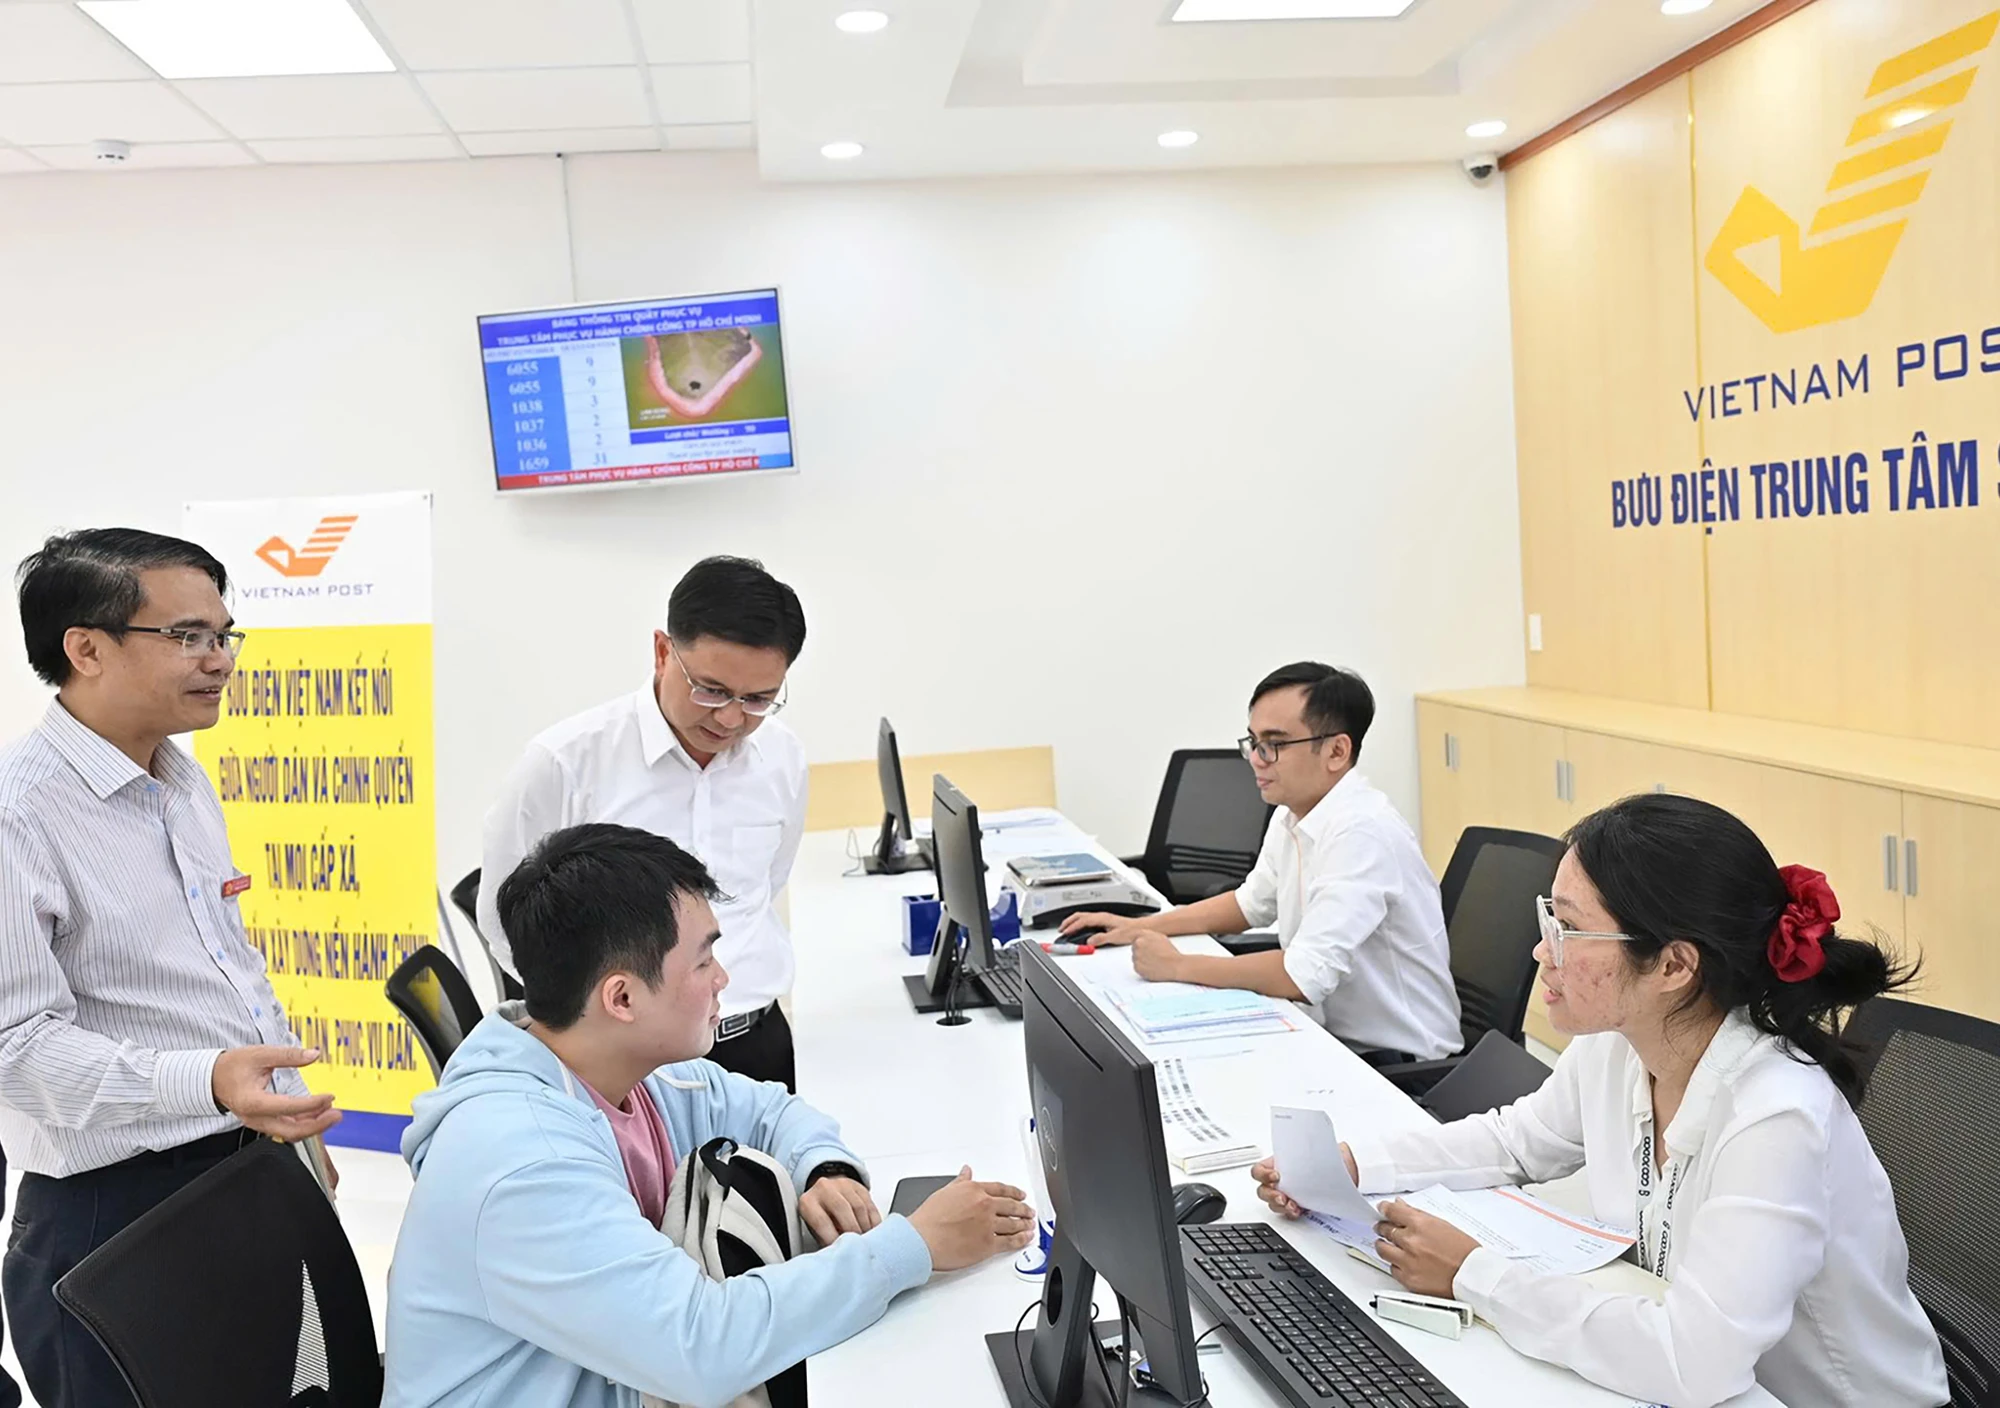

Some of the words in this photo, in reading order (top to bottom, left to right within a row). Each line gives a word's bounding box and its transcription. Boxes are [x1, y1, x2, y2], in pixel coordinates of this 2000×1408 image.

[685, 319, 697, 329] TP
[506, 361, 539, 376] 6055
[586, 357, 594, 367] 9
[508, 380, 541, 395] 6055
[588, 376, 596, 387] 9
[1683, 353, 1869, 422] VIETNAM
[512, 399, 544, 415] 1038
[515, 418, 545, 433] 1037
[593, 414, 600, 427] 2
[517, 438, 547, 453] 1036
[595, 433, 602, 446] 2
[520, 457, 549, 471] 1659
[593, 453, 607, 465] 31
[1611, 472, 1661, 528] BƯU
[1671, 458, 1740, 535] ĐIỆN
[1749, 452, 1869, 520] TRUNG
[1882, 431, 1979, 512] TÂM
[241, 586, 320, 599] VIETNAM
[327, 583, 374, 596] POST
[253, 658, 281, 728] ĐIỆN
[286, 658, 311, 728] VIỆT
[315, 669, 343, 716] NAM
[347, 651, 368, 716] KẾT
[372, 650, 393, 716] NỐI
[283, 746, 309, 803] DÂN
[313, 745, 328, 803] VÀ
[333, 746, 370, 803] CHÍNH
[285, 843, 308, 901] MỌI
[311, 826, 335, 892] CẤP
[353, 921, 388, 981] HÀNH
